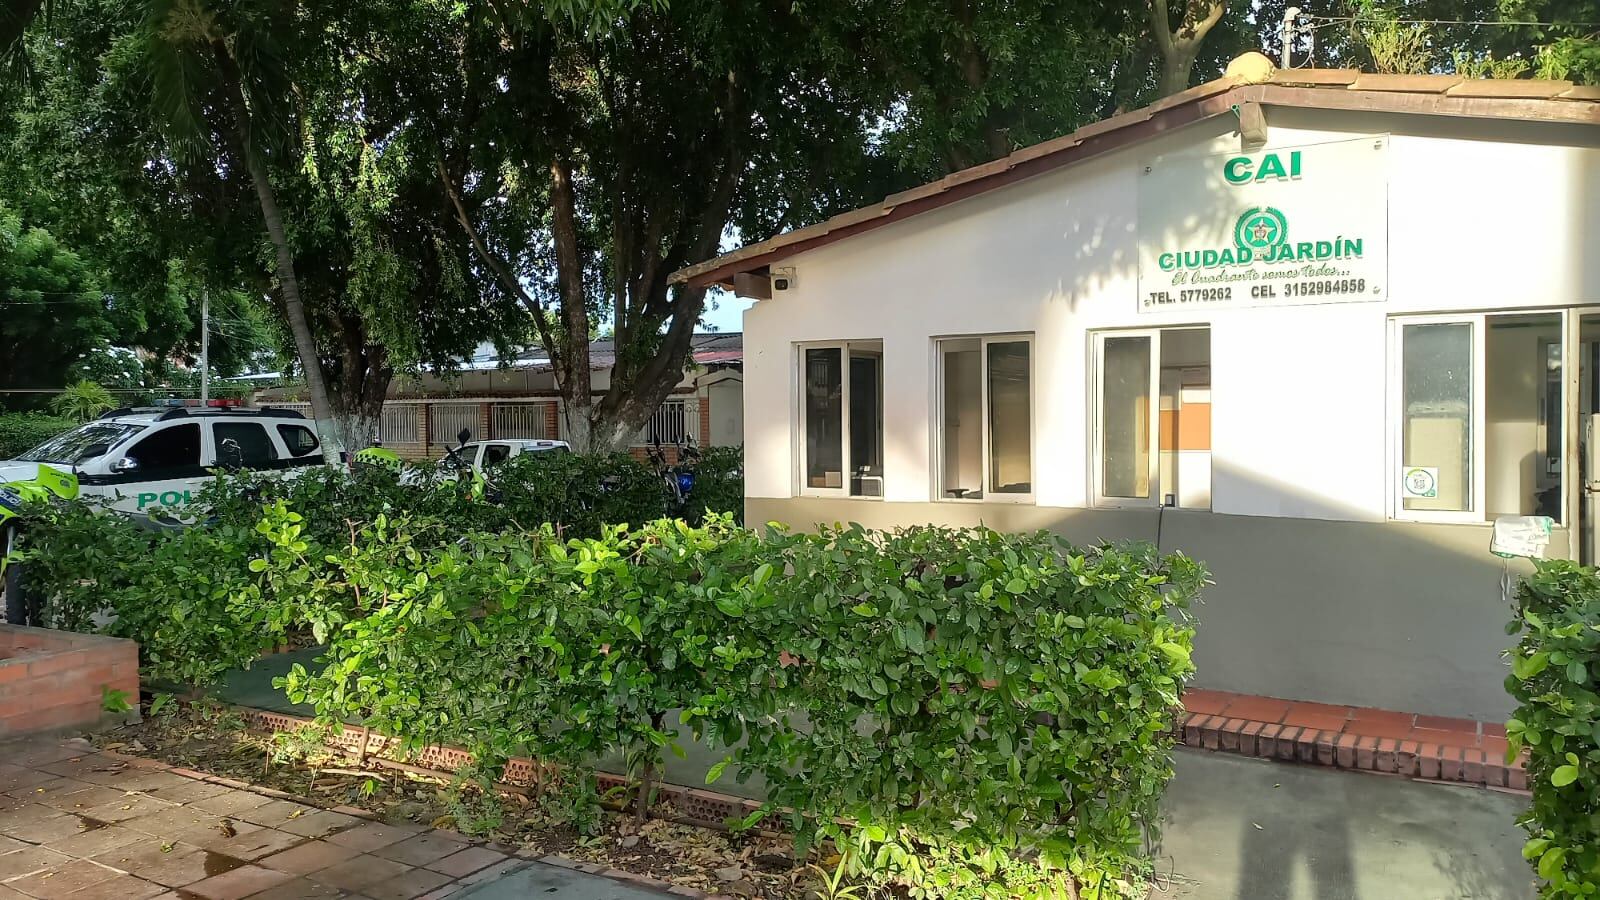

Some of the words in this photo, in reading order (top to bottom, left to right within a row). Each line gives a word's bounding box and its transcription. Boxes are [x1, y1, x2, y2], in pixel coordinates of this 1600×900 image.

[1223, 151, 1302, 184] CAI
[1158, 247, 1253, 271] CIUDAD
[1262, 235, 1363, 262] JARDÍN
[1150, 291, 1176, 304] TEL.
[1180, 287, 1232, 303] 5779262
[1251, 284, 1276, 299] CEL
[1284, 278, 1366, 298] 3152984858
[1172, 271, 1188, 286] El
[1262, 270, 1299, 280] somos
